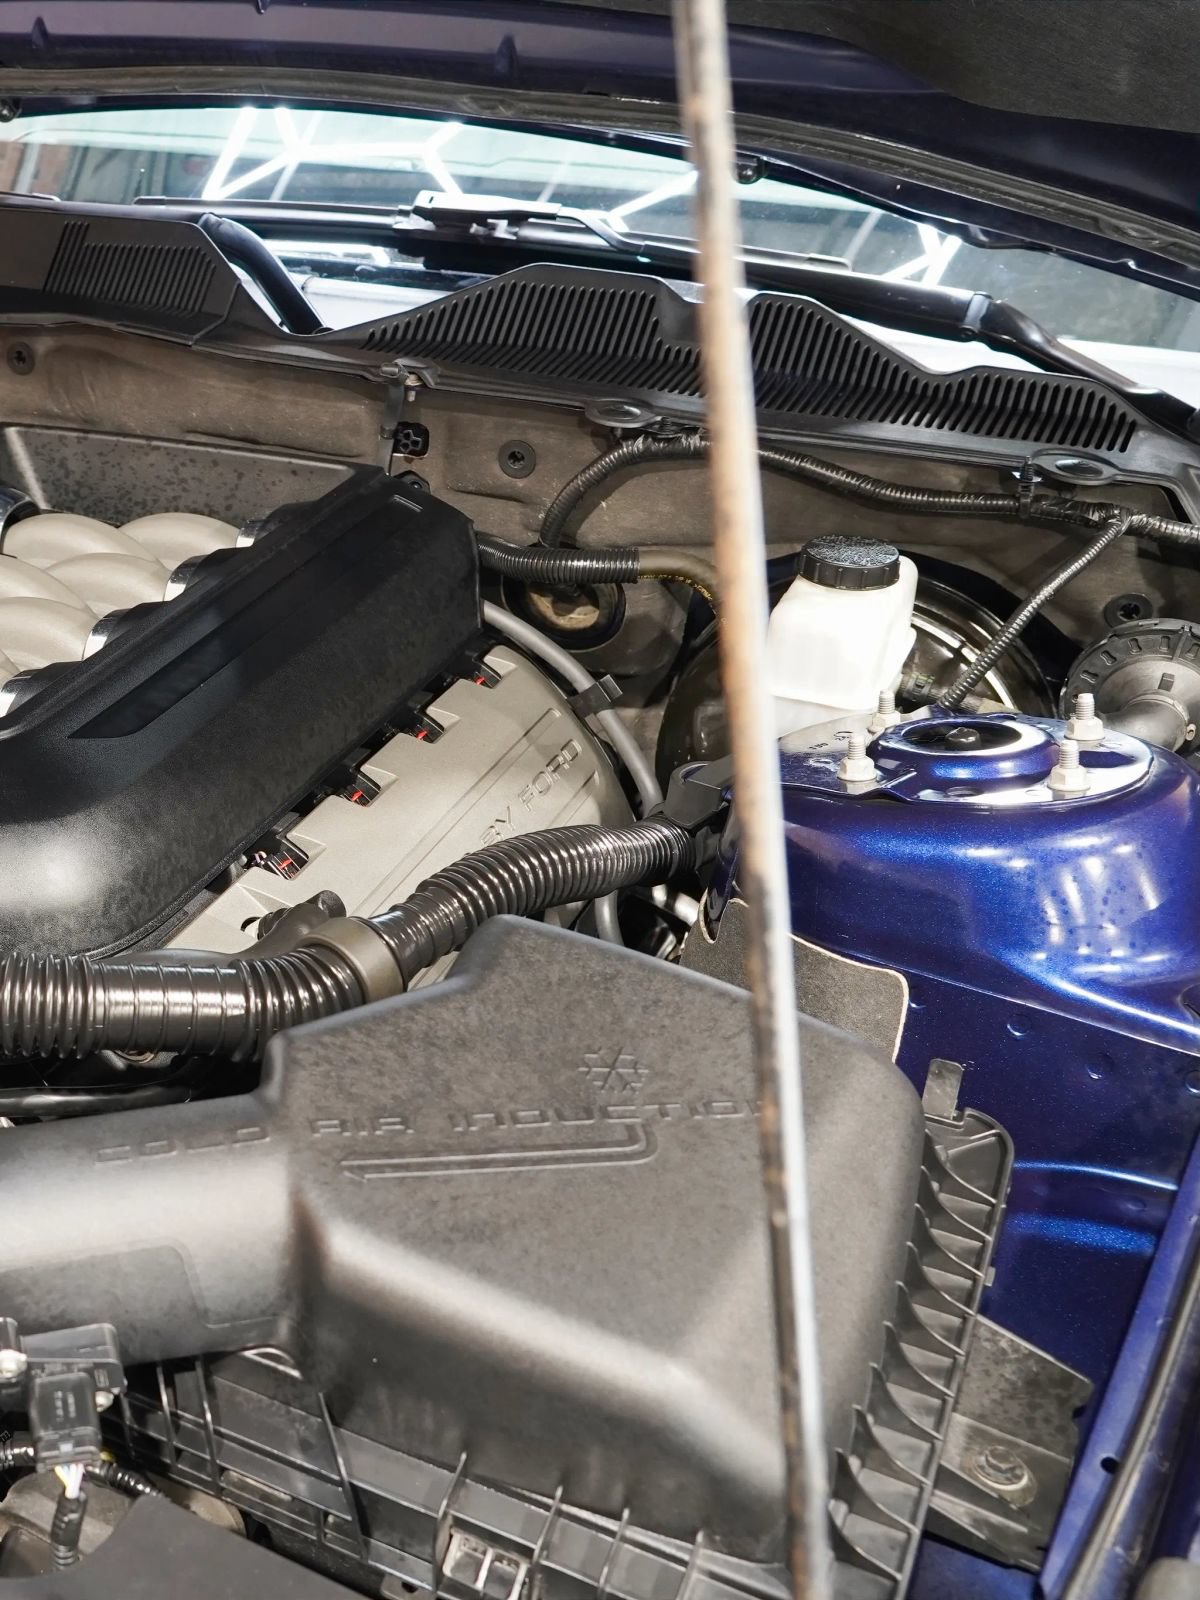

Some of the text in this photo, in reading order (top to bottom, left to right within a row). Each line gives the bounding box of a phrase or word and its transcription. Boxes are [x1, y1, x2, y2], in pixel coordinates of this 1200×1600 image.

[518, 738, 582, 812] FORD
[96, 1126, 271, 1166] COLD
[313, 1116, 415, 1138] AIR
